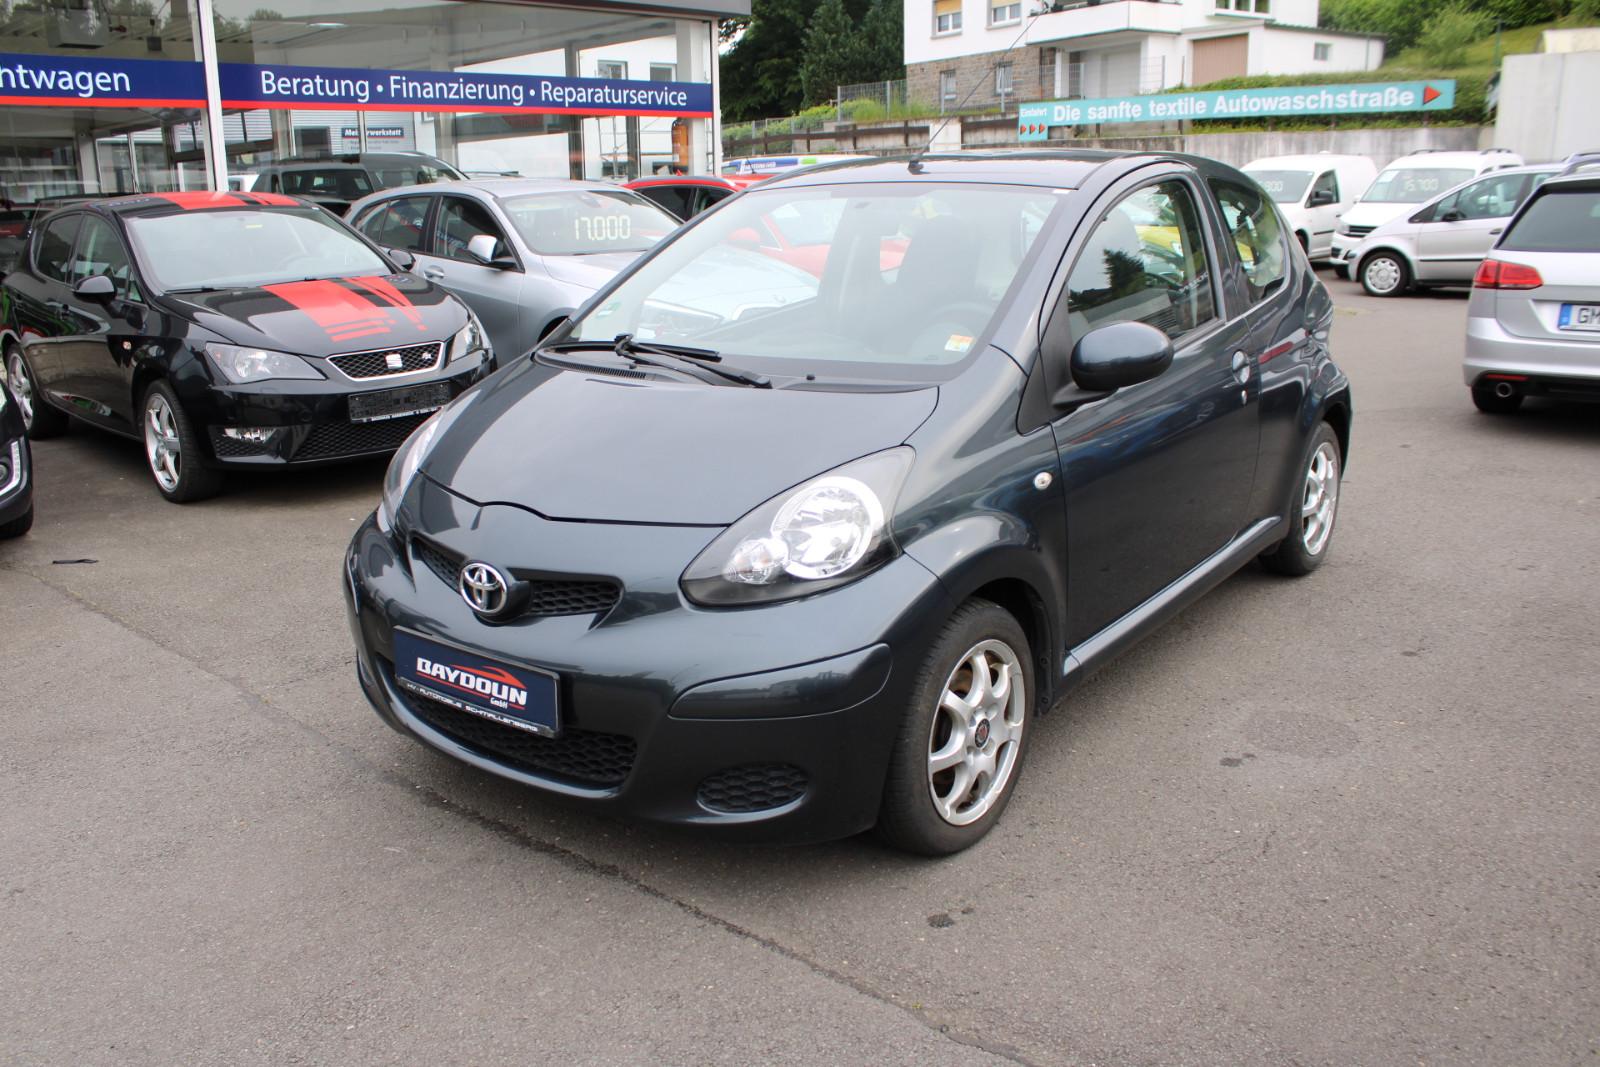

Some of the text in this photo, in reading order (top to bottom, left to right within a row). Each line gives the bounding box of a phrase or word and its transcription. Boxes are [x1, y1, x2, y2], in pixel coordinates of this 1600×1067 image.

[261, 70, 687, 107] Beratung Finanzierung Reparaturservice
[1053, 87, 1415, 122] Die sanfte textile Autowaschstraße
[575, 214, 631, 241] 17.000
[416, 657, 527, 706] BAYDOUN
